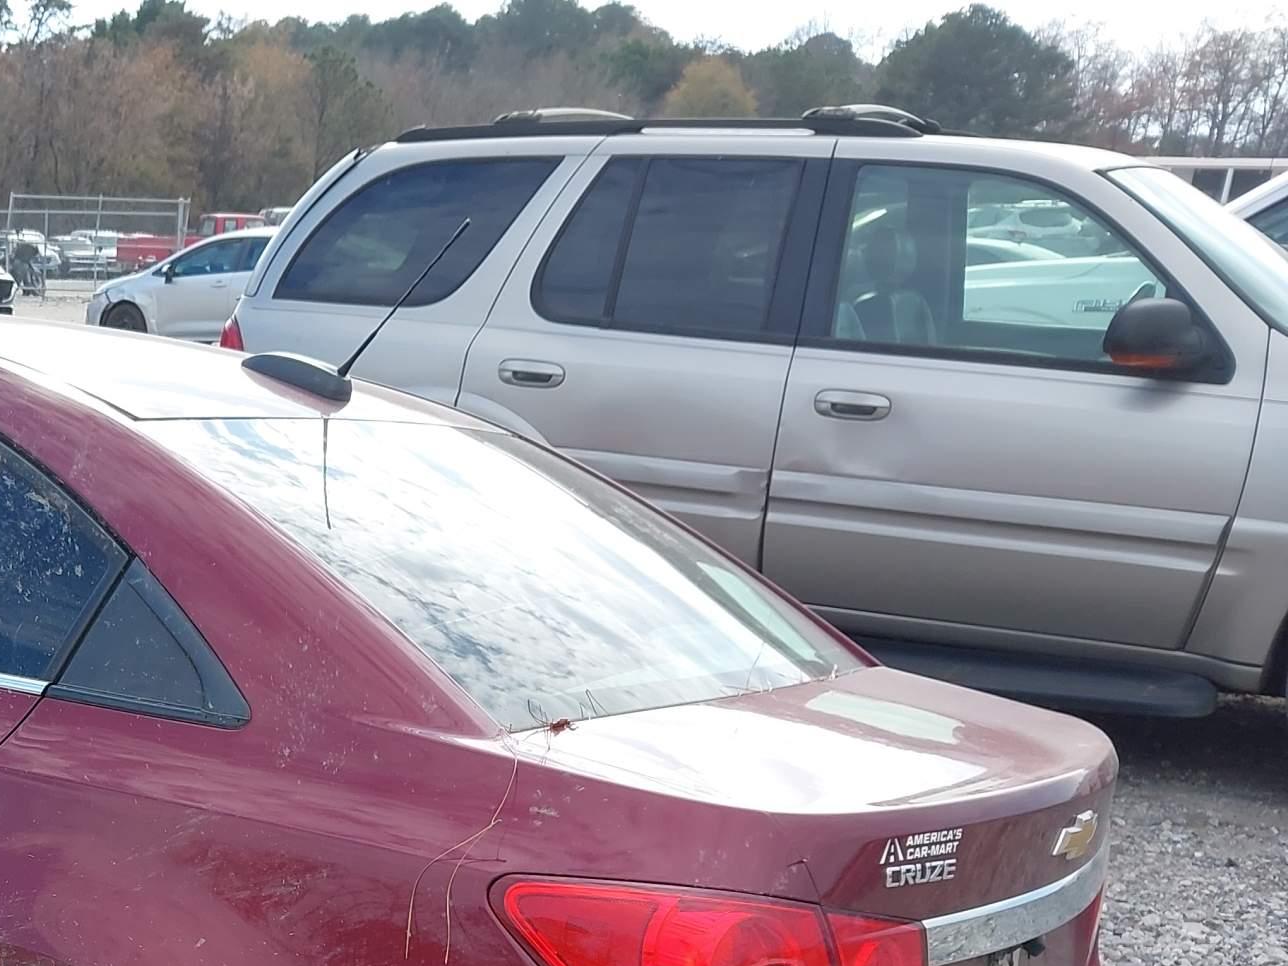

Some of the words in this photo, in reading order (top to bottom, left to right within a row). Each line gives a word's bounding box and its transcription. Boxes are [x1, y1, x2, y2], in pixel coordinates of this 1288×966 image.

[905, 828, 963, 846] AMERICA'S
[906, 841, 959, 860] CAR-MART
[886, 858, 957, 888] CRUZE
